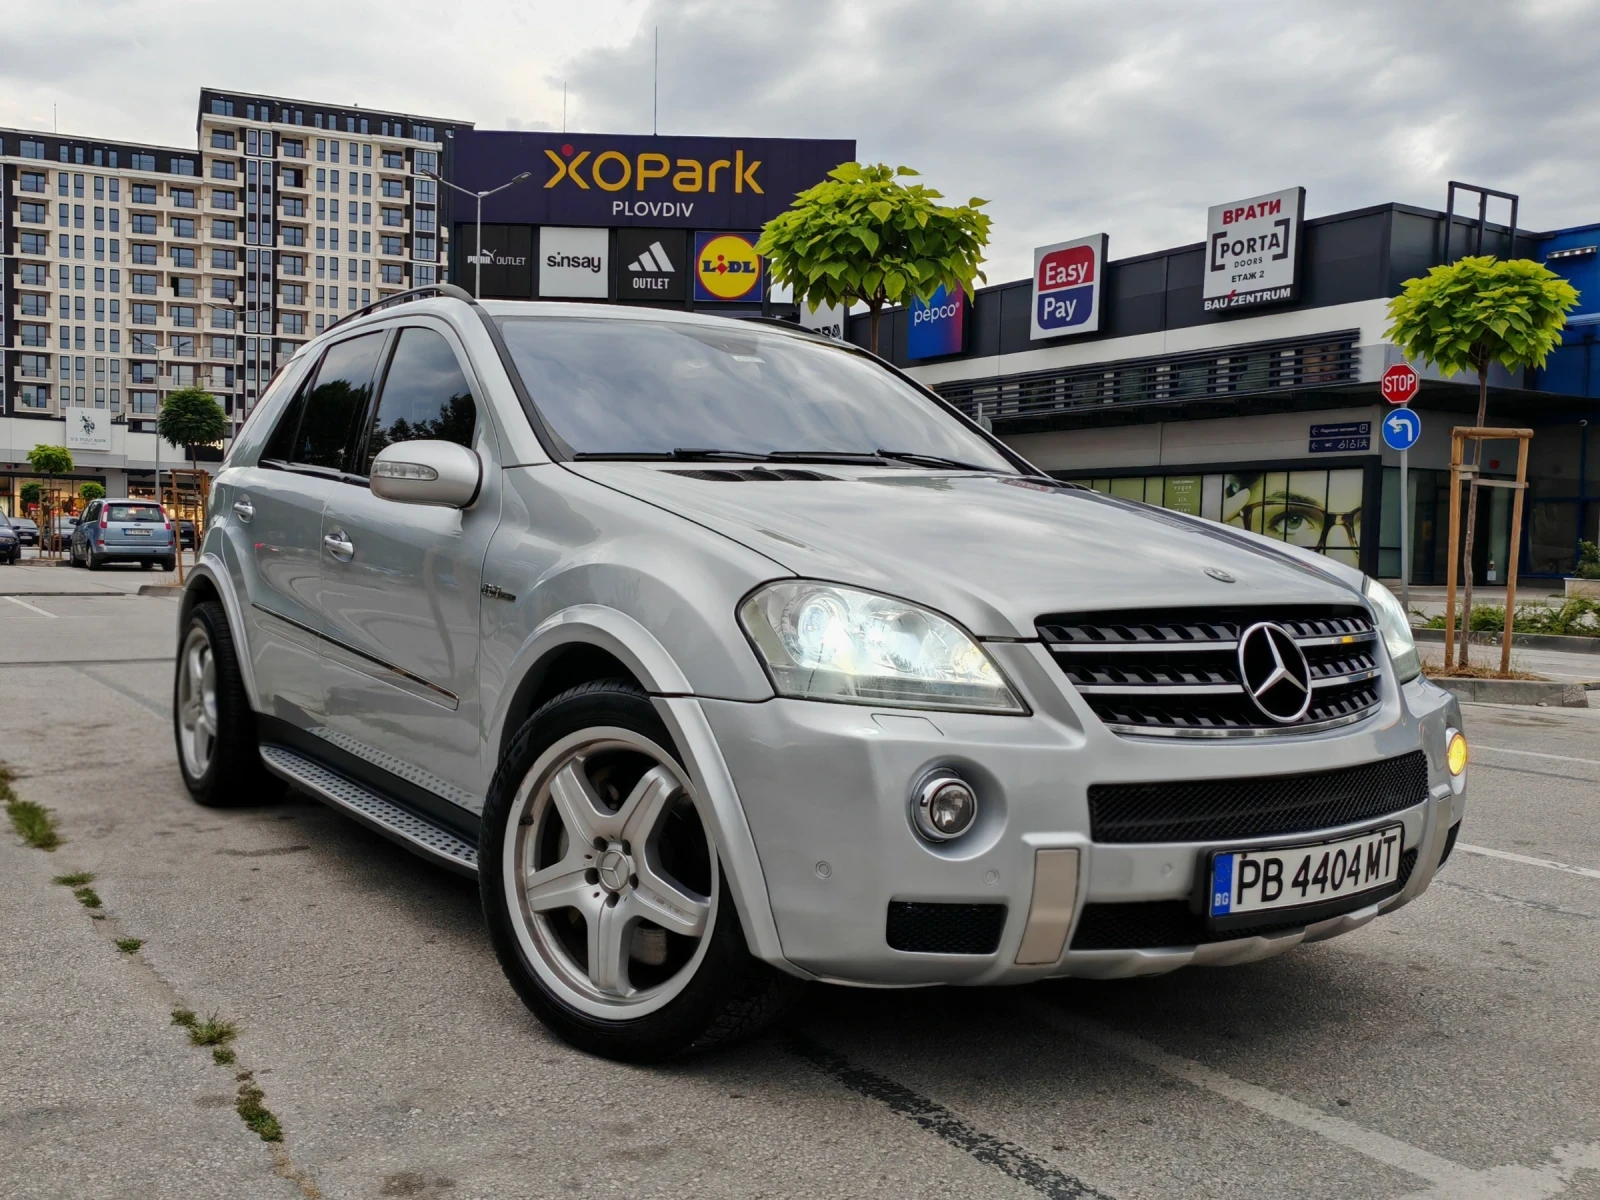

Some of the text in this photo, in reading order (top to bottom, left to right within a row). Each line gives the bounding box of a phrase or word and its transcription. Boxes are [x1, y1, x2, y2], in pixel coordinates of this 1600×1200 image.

[612, 201, 695, 218] PLOVDIV
[1222, 199, 1282, 226] ВРАТИ
[1220, 232, 1281, 259] PORTA
[496, 256, 526, 266] OUTLET
[546, 252, 602, 273] sinsay
[1234, 257, 1263, 268] DOORS
[632, 277, 670, 290] OUTLET
[1045, 261, 1089, 286] Easy
[1231, 270, 1265, 283] ЕТАЖ 2
[1043, 297, 1078, 321] Pay
[1204, 287, 1291, 311] BAU ZENTRUM
[1384, 374, 1415, 393] STOP
[1236, 834, 1397, 905] PB 4404 MT
[1214, 892, 1229, 907] BG
